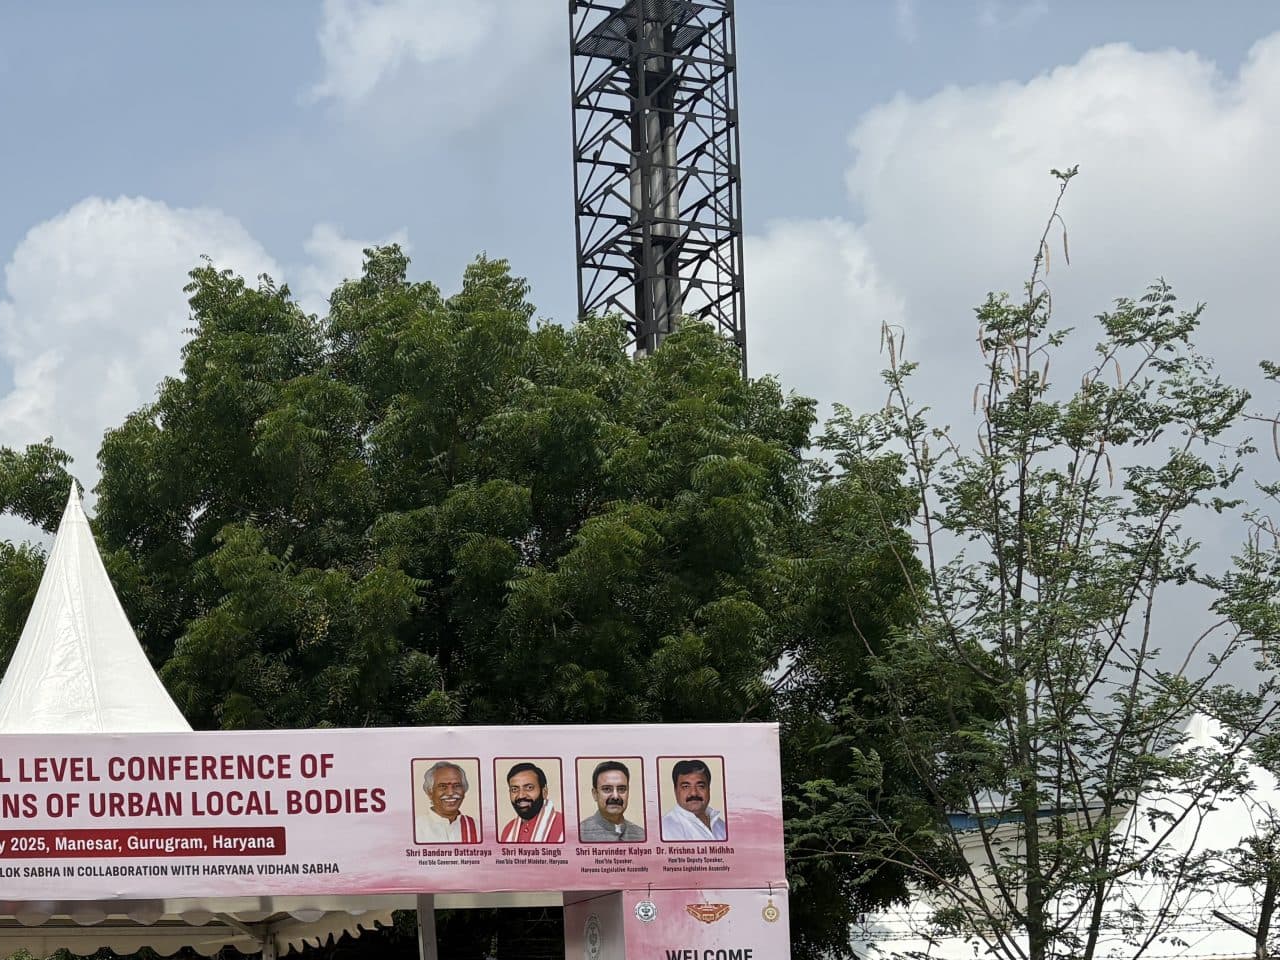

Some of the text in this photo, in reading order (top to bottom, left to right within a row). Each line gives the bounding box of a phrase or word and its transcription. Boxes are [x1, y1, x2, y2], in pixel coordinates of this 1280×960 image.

[19, 757, 101, 782] LEVEL
[108, 754, 292, 781] CONFERENCE
[300, 753, 335, 779] OF
[46, 793, 80, 818] OF
[89, 791, 182, 818] URBAN
[191, 790, 278, 816] LOCAL
[286, 788, 387, 815] BODIES
[10, 836, 50, 853] 2025,
[55, 835, 123, 853] Manesar,
[127, 835, 208, 852] Gurugram,
[212, 834, 275, 851] Haryana
[405, 848, 492, 857] Shri Bandaru Dattatraya
[501, 847, 562, 857] Shri Nayab Singh
[576, 847, 652, 857] Shri Harvinder Kalyan
[656, 846, 735, 855] Dr. Krishna Lal Midhha
[0, 867, 21, 878] LOK
[23, 866, 61, 878] SABHA
[63, 866, 75, 877] IN
[77, 865, 168, 877] COLLABORATION
[171, 864, 201, 876] WITH
[202, 864, 255, 876] HARYANA
[256, 864, 299, 875] VIDHAN
[302, 863, 340, 874] SABHA
